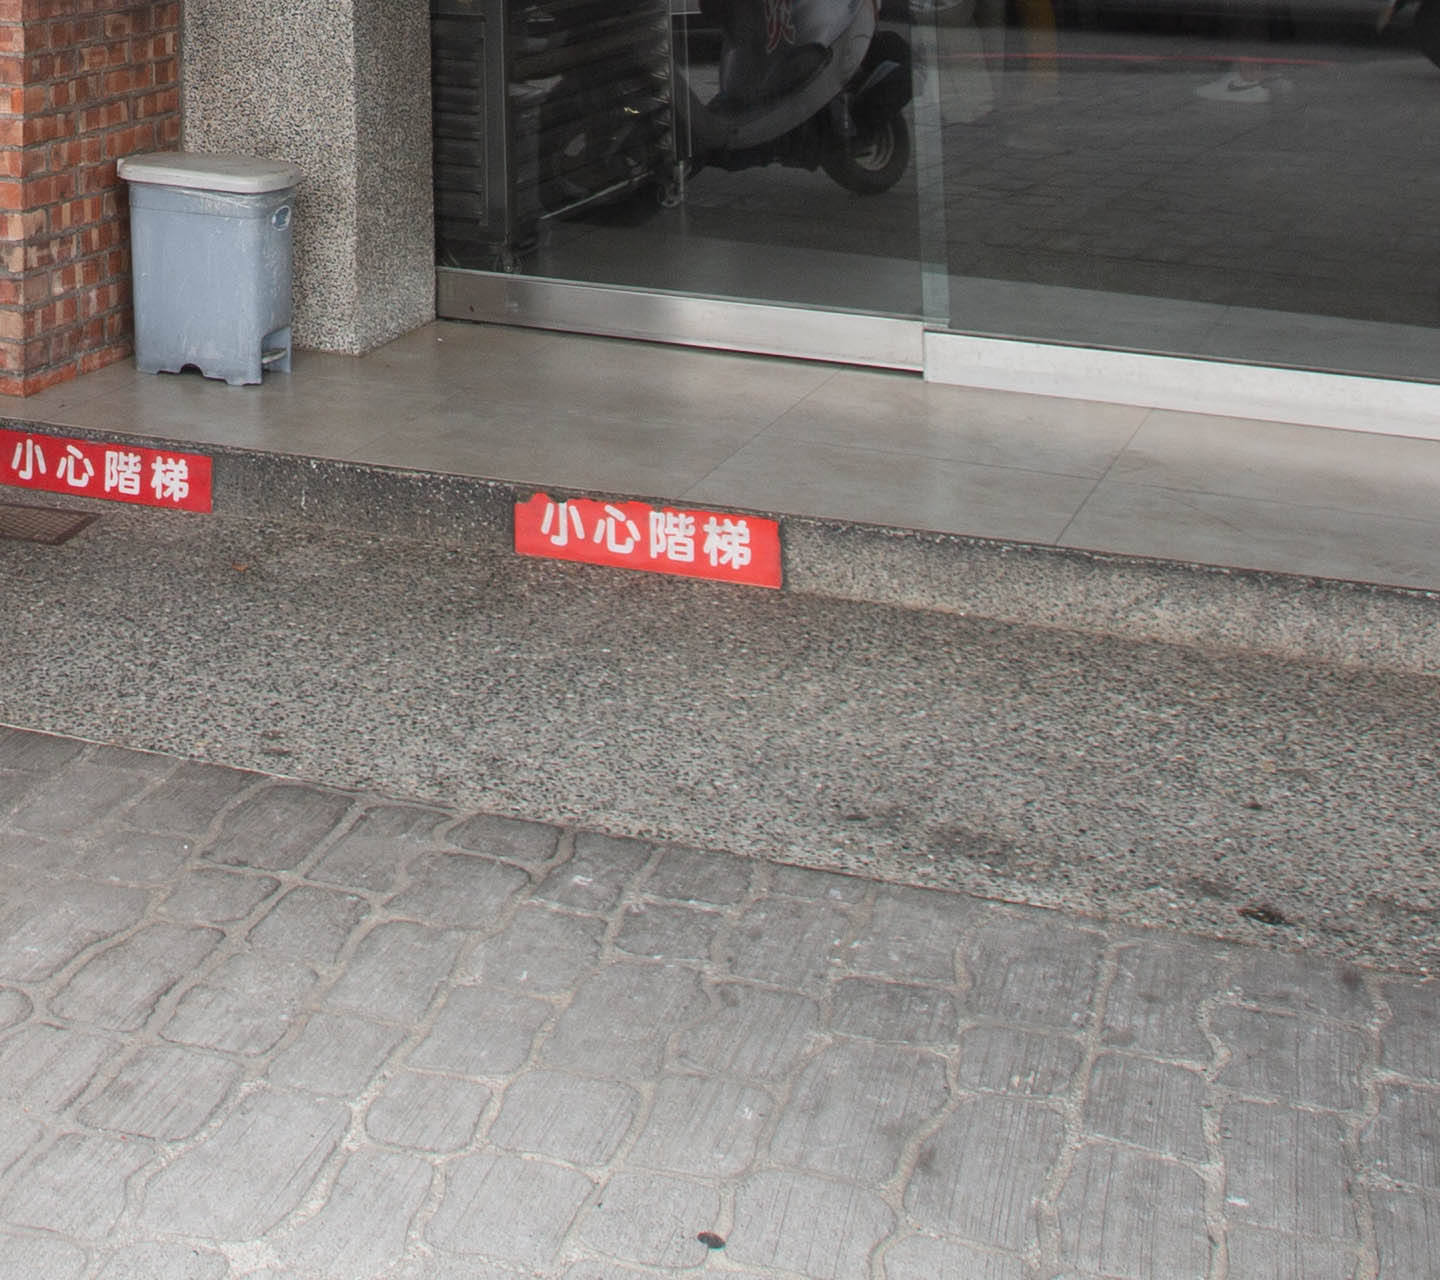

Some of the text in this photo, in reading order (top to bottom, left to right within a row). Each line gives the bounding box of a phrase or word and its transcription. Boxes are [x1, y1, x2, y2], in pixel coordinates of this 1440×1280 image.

[9, 439, 192, 503] 小心階梯
[540, 500, 752, 571] 小心階梯
